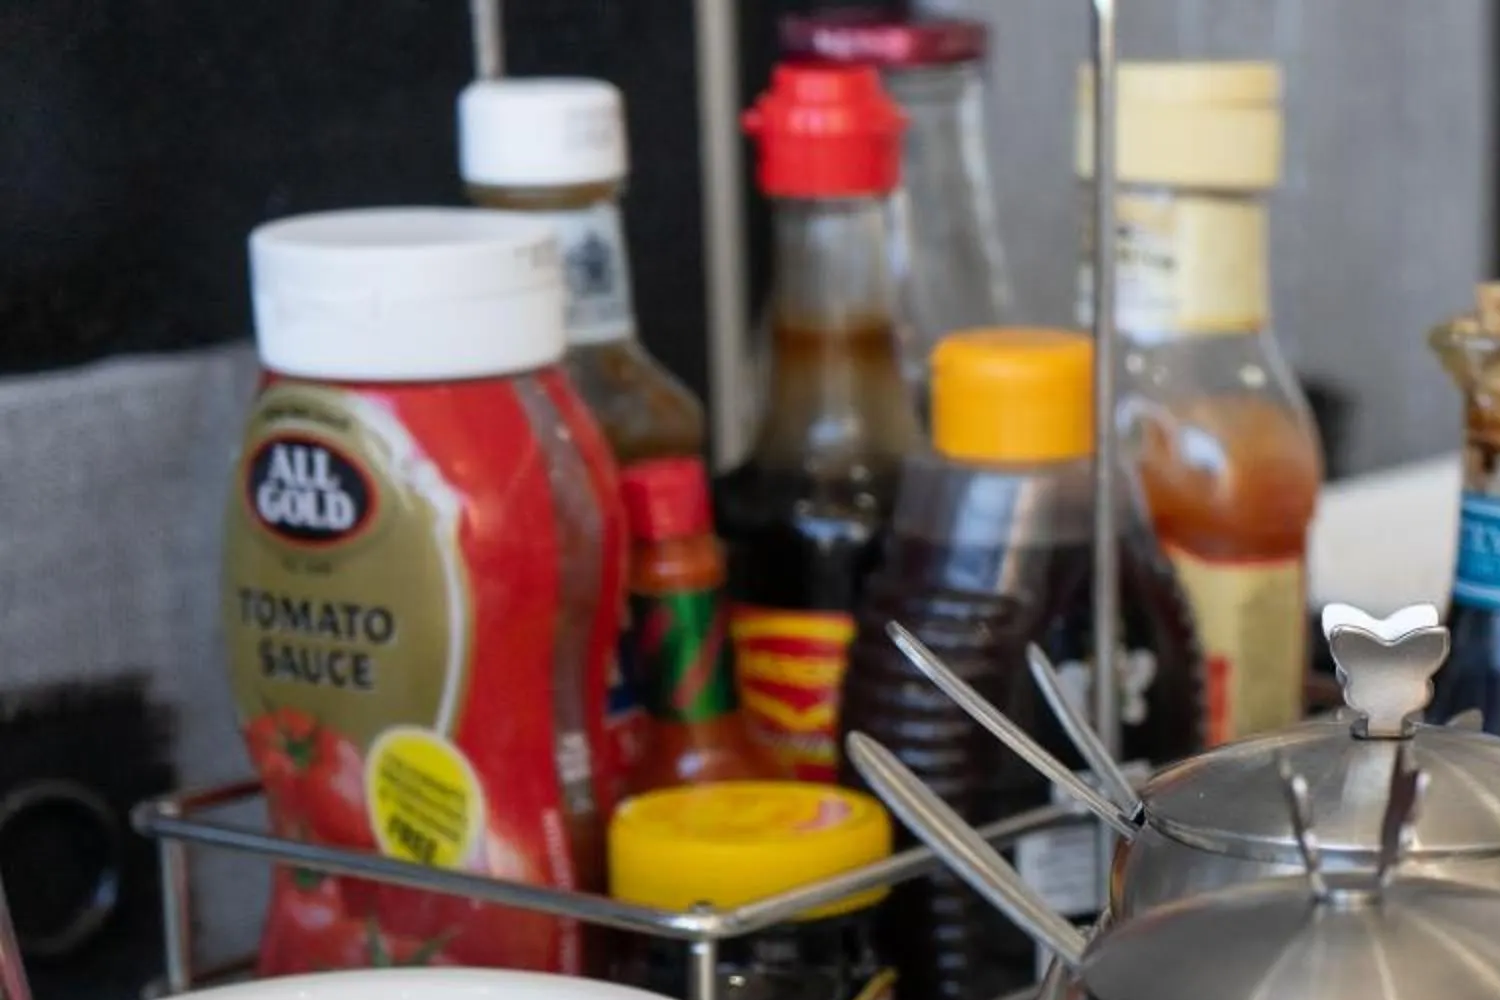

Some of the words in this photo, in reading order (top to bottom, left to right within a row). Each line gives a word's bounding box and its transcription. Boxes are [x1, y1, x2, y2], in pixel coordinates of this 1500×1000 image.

[268, 443, 340, 490] ALL
[256, 480, 358, 532] GOLD
[238, 586, 395, 645] TOMATO
[258, 638, 376, 691] SAUCE
